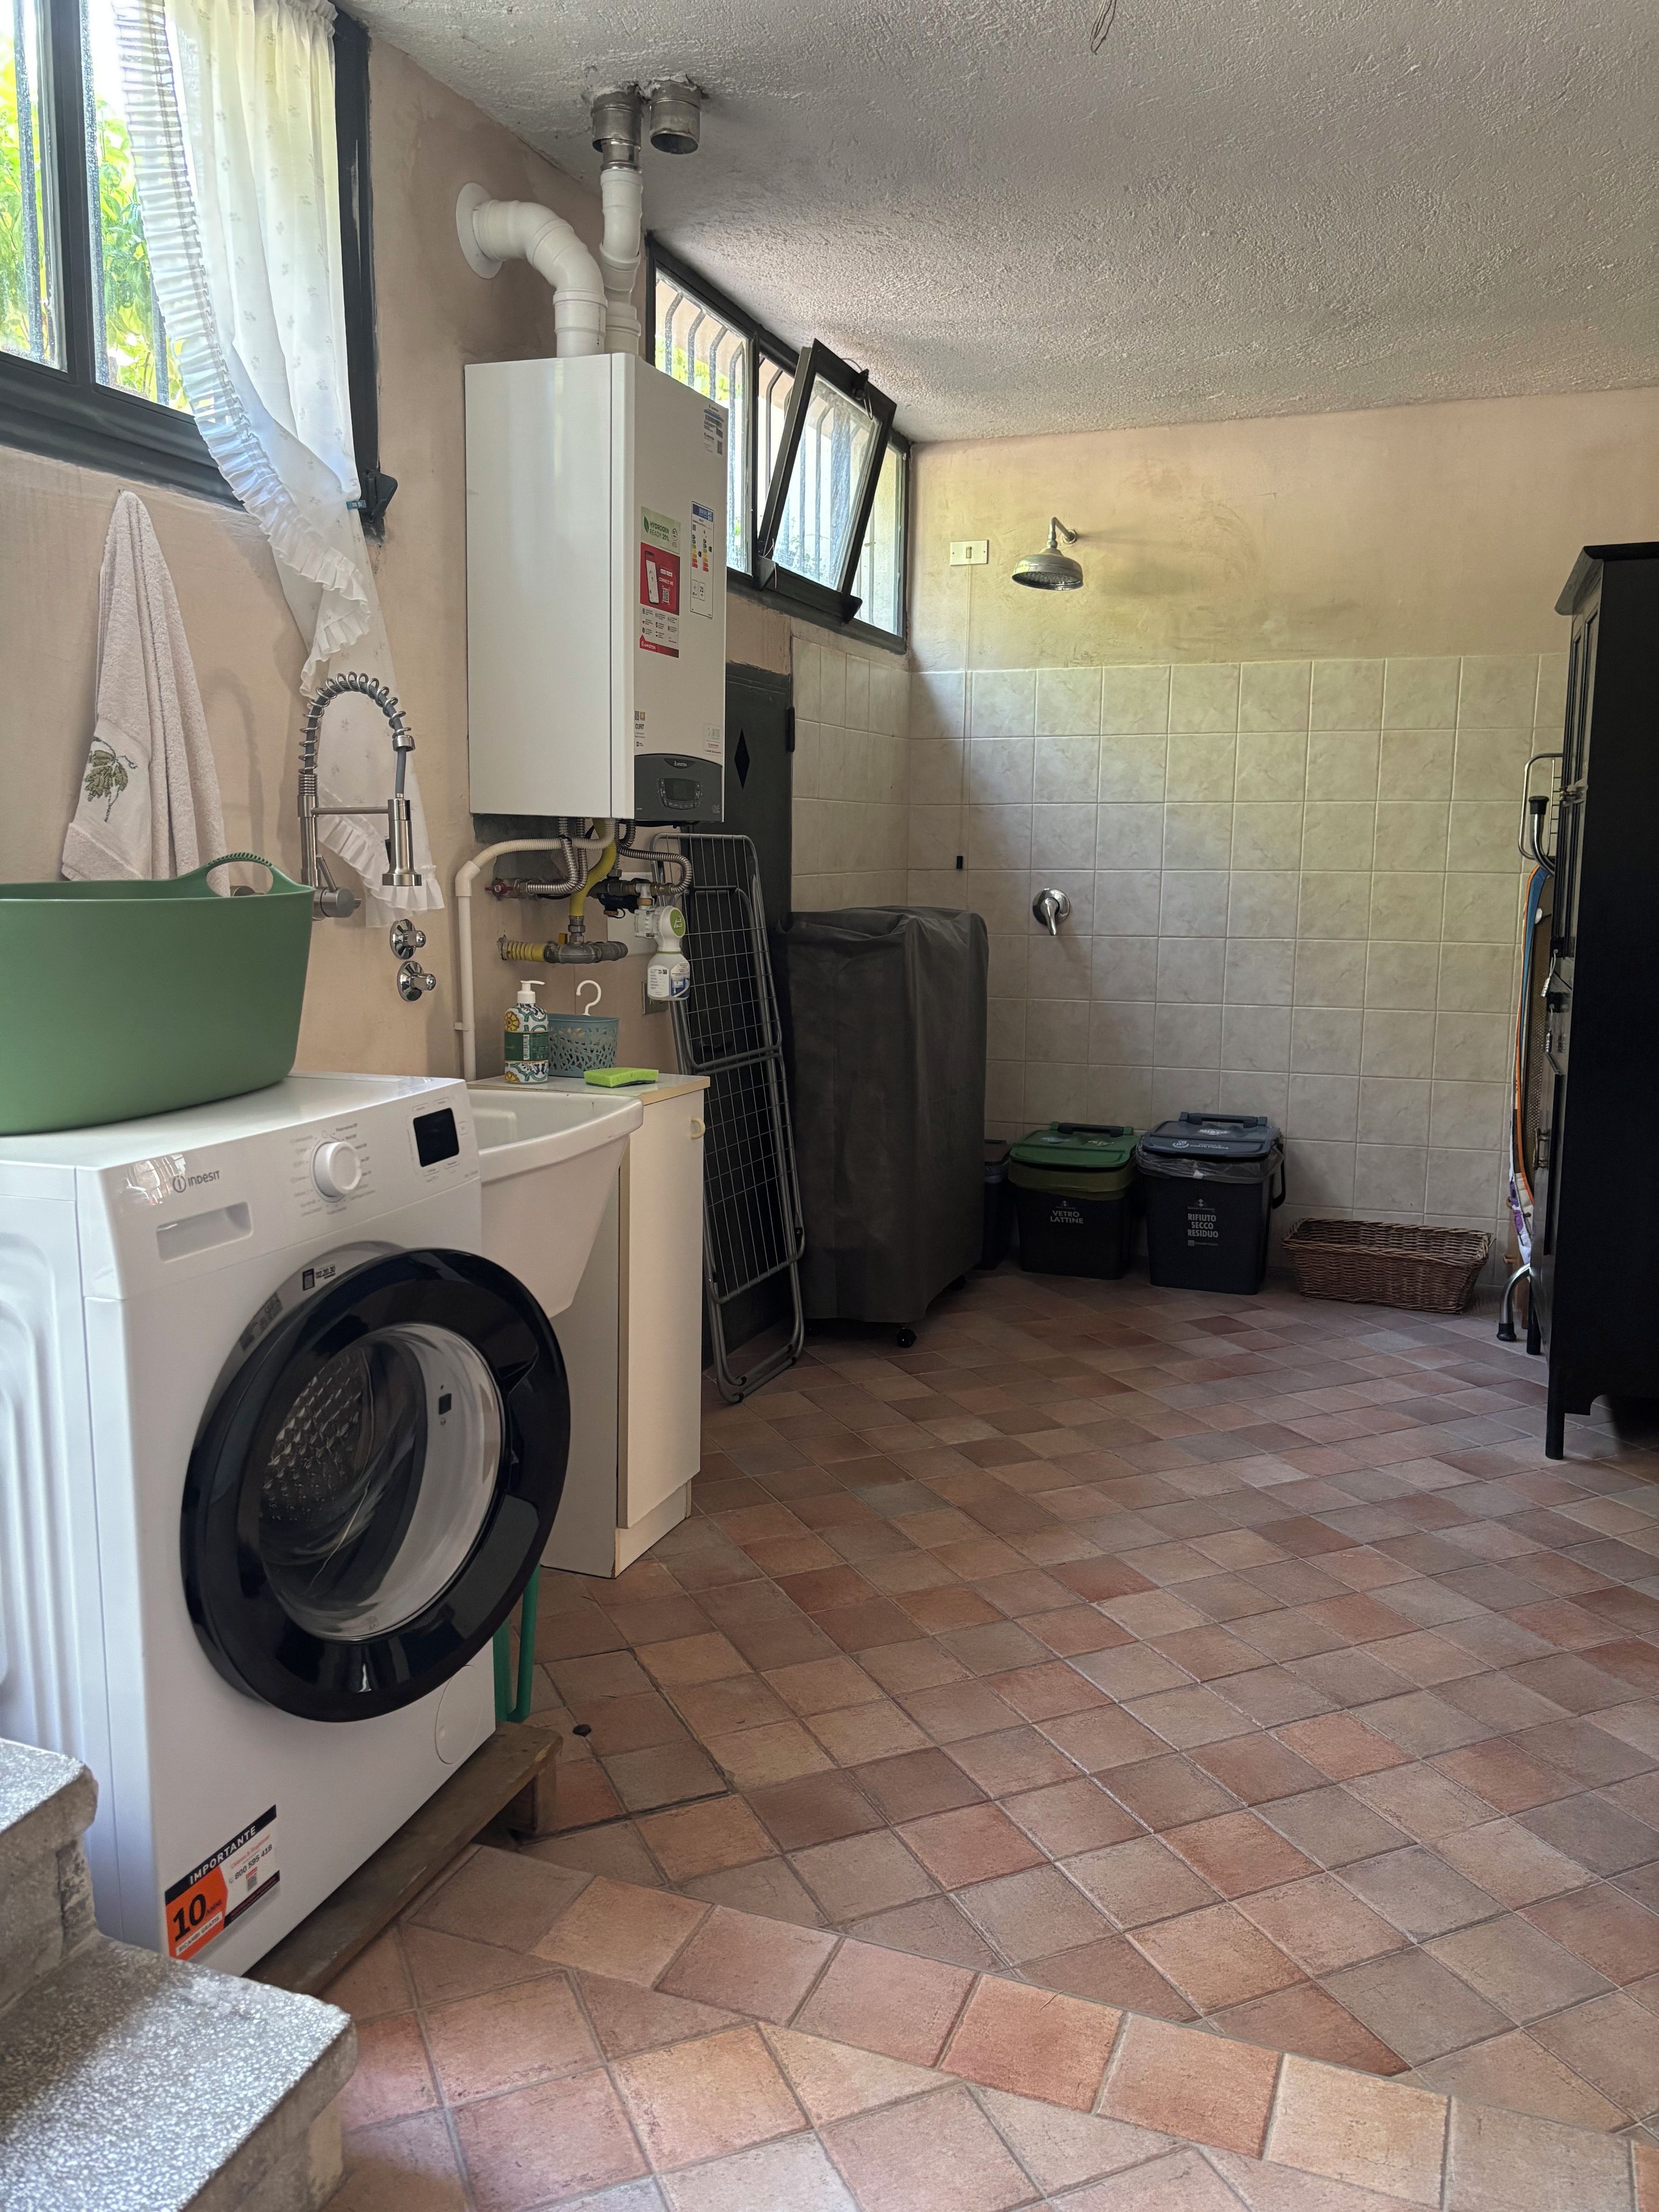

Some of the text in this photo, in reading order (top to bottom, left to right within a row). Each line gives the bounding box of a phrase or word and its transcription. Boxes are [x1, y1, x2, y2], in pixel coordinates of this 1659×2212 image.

[649, 521, 669, 534] HYDROGEN
[649, 529, 662, 539] READY
[1052, 1210, 1080, 1218] VETRO
[1187, 1213, 1217, 1222] RIFIUTO
[1050, 1216, 1084, 1224] LATTINE
[1191, 1221, 1214, 1230] SECCO
[1187, 1229, 1219, 1238] RESIDUO
[190, 1825, 256, 1885] IMPORTANTE
[234, 1843, 272, 1880] 800 595 418
[173, 1893, 206, 1942] 10
[178, 1931, 200, 1953] RICAMBI
